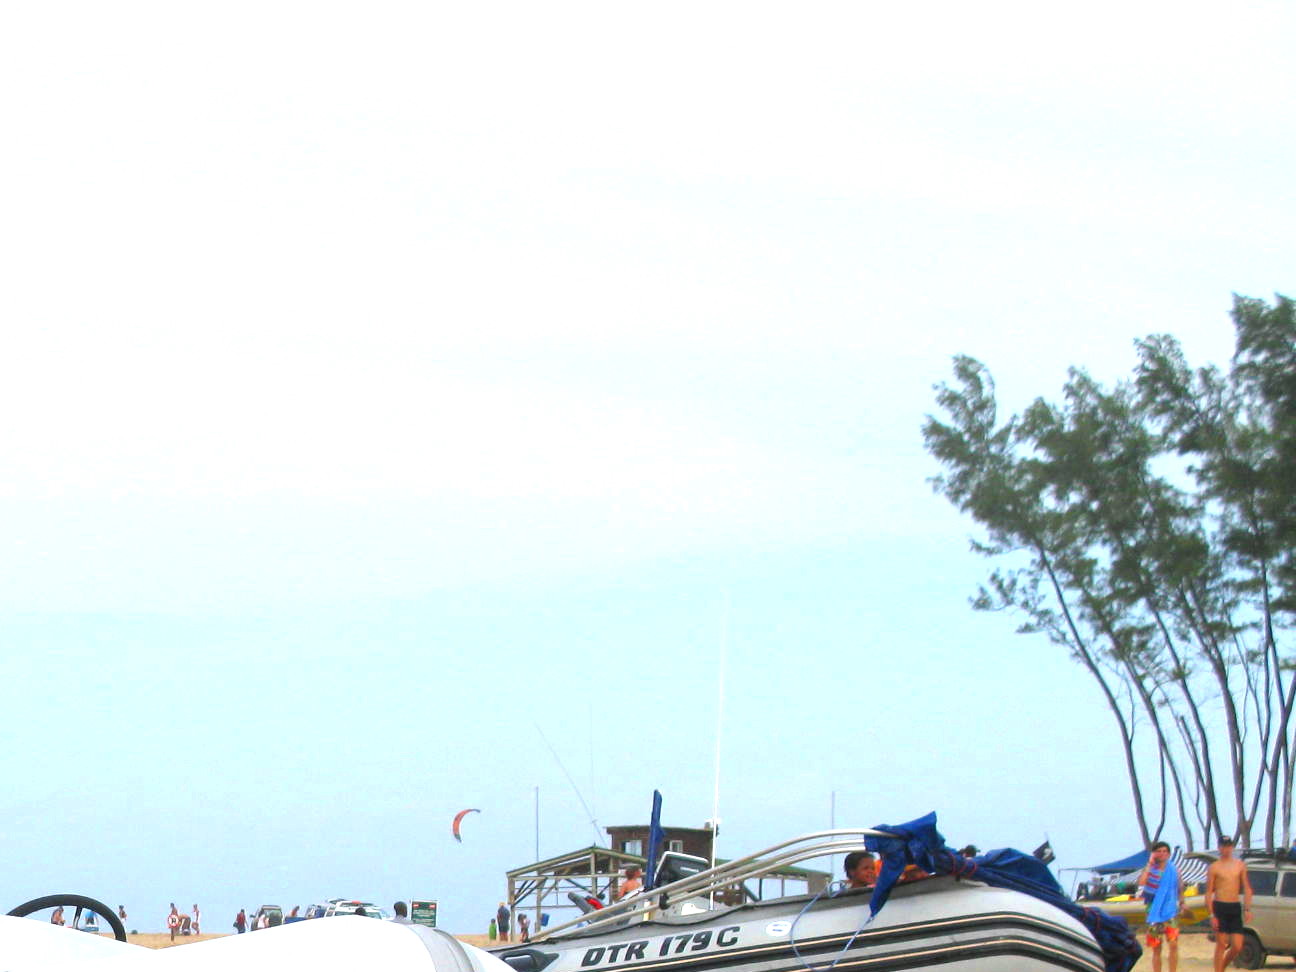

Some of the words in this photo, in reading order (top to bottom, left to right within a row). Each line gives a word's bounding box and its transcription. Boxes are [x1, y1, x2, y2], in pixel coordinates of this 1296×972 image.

[581, 940, 649, 967] DTR
[659, 930, 712, 957] 179
[716, 926, 740, 947] C
